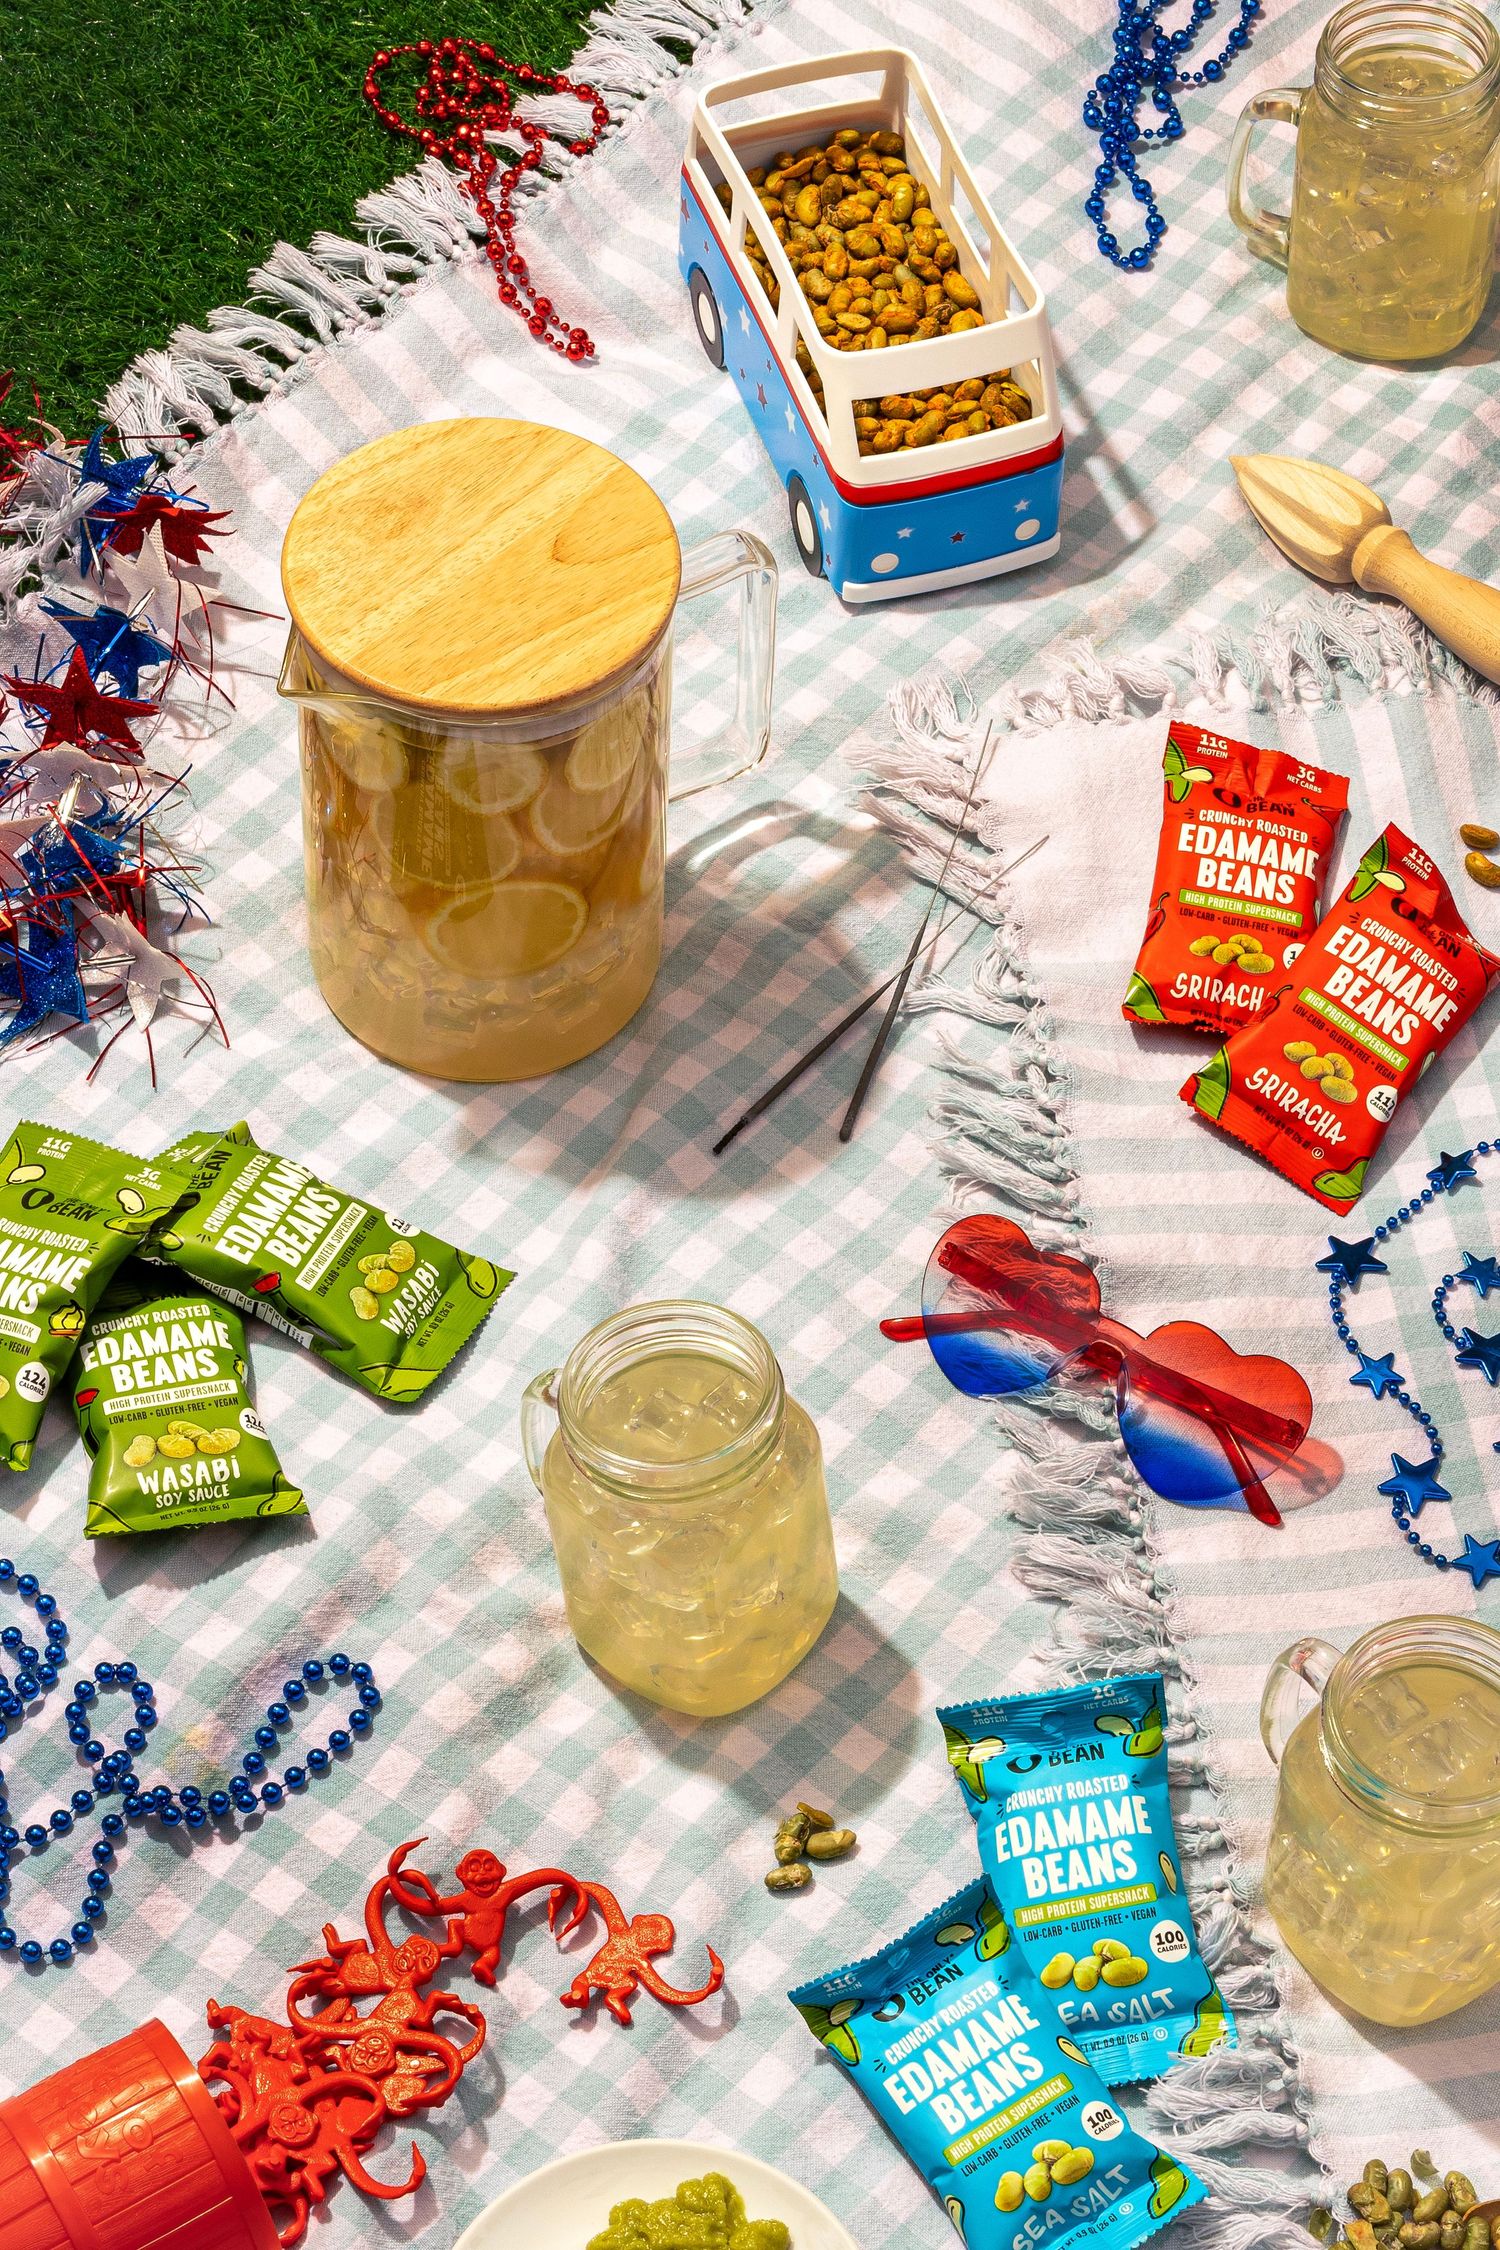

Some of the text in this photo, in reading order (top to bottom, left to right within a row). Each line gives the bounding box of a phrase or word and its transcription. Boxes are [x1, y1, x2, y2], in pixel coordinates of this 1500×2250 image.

[1197, 746, 1229, 759] PROTEIN
[1200, 734, 1228, 750] 11G
[1287, 774, 1322, 794] NET CARBS
[1296, 766, 1316, 783] 3G
[1246, 801, 1296, 817] BEAN
[1199, 809, 1308, 844] CRUNCHY ROASTED
[1178, 823, 1319, 881] EDAMAME
[1401, 856, 1430, 881] PROTEIN
[1408, 847, 1433, 873] 11G
[1196, 857, 1296, 905] BEANS
[1180, 907, 1299, 940] LOW-CARB GLUTEN-FREE VEGAN
[1185, 892, 1298, 924] HIGH PROTEIN SUPERSNACK
[1360, 917, 1412, 956] CRUNCHY
[1409, 946, 1458, 992] ROASTED
[1169, 972, 1271, 1012] SRIRACH
[1323, 924, 1458, 1033] EDAMAME
[1323, 963, 1420, 1045] BEANS
[1292, 1003, 1398, 1082] LOW-CARB GLUTEN-FREE VEGAN
[1305, 992, 1405, 1067] HIGH PROTEIN SUPERSNACK
[1245, 1067, 1347, 1146] SRIRACHA
[37, 1148, 66, 1160] PROTEIN
[42, 1137, 72, 1152] 11G
[124, 1174, 162, 1191] NET CARBS
[137, 1167, 161, 1181] 3G
[196, 1150, 233, 1190] BEAN
[203, 1189, 243, 1233] CRUNCHY
[237, 1154, 272, 1194] ROASTED
[47, 1201, 99, 1222] BEAN
[214, 1158, 315, 1265] EDAMAME
[264, 1186, 341, 1268] BEANS
[39, 1229, 90, 1252] ROASTED
[301, 1207, 362, 1285] HIGH PROTEIN SUPERSNACK
[316, 1215, 380, 1297] LOW-CARB GLUTEN-FREE VEGAN
[92, 1313, 150, 1336] CRUNCHY
[152, 1304, 211, 1322] ROASTED
[404, 1285, 443, 1339] SOY SAUCE
[8, 1341, 32, 1357] VEGAN
[80, 1320, 233, 1372] EDAMAME
[22, 1369, 46, 1391] 124
[110, 1348, 219, 1393] BEANS
[18, 1380, 45, 1397] CALORIES
[110, 1382, 231, 1410] HIGH PROTEIN SUPERSNACK
[109, 1397, 239, 1425] LOW-CARB GLUTEN-FREE VEGAN
[155, 1484, 230, 1509] SOY SAUCE
[1092, 1685, 1115, 1700] 2G
[1101, 1696, 1129, 1708] CARBS
[973, 1715, 1008, 1726] PROTEIN
[1049, 1743, 1105, 1767] BEAN
[1006, 1773, 1128, 1813] CRUNCHY ROASTED
[995, 1795, 1152, 1864] EDAMAME
[1022, 1840, 1138, 1899] BEANS
[1021, 1887, 1150, 1924] HIGH PROTEIN SUPERSNACK
[1023, 1907, 1157, 1942] LOW-CARB GLUTEN-FREE VEGAN
[1155, 1930, 1184, 1946] 100
[1157, 1942, 1187, 1954] CALORIES
[905, 1956, 953, 1989] THE ONLY
[907, 1963, 965, 2007] BEAN
[884, 1980, 1001, 2066] CRUNCHY ROASTED
[1057, 1987, 1176, 2026] EA SALT
[883, 1993, 1040, 2115] EDAMAME
[1079, 2043, 1090, 2054] ET
[1103, 2037, 1115, 2049] 0.9
[1116, 2035, 1127, 2046] OZ
[1127, 2033, 1139, 2045] (26
[1141, 2031, 1149, 2043] G)
[929, 2042, 1044, 2135] BEANS
[951, 2078, 1067, 2161] HIGH PROTEIN SUPERSNACK
[1087, 2108, 1113, 2128] 100
[1094, 2118, 1120, 2135] CALORIES
[960, 2094, 1081, 2178] LOW-CARB GLUTEN-FREE VEGAN
[1012, 2164, 1131, 2250] SEA SALT
